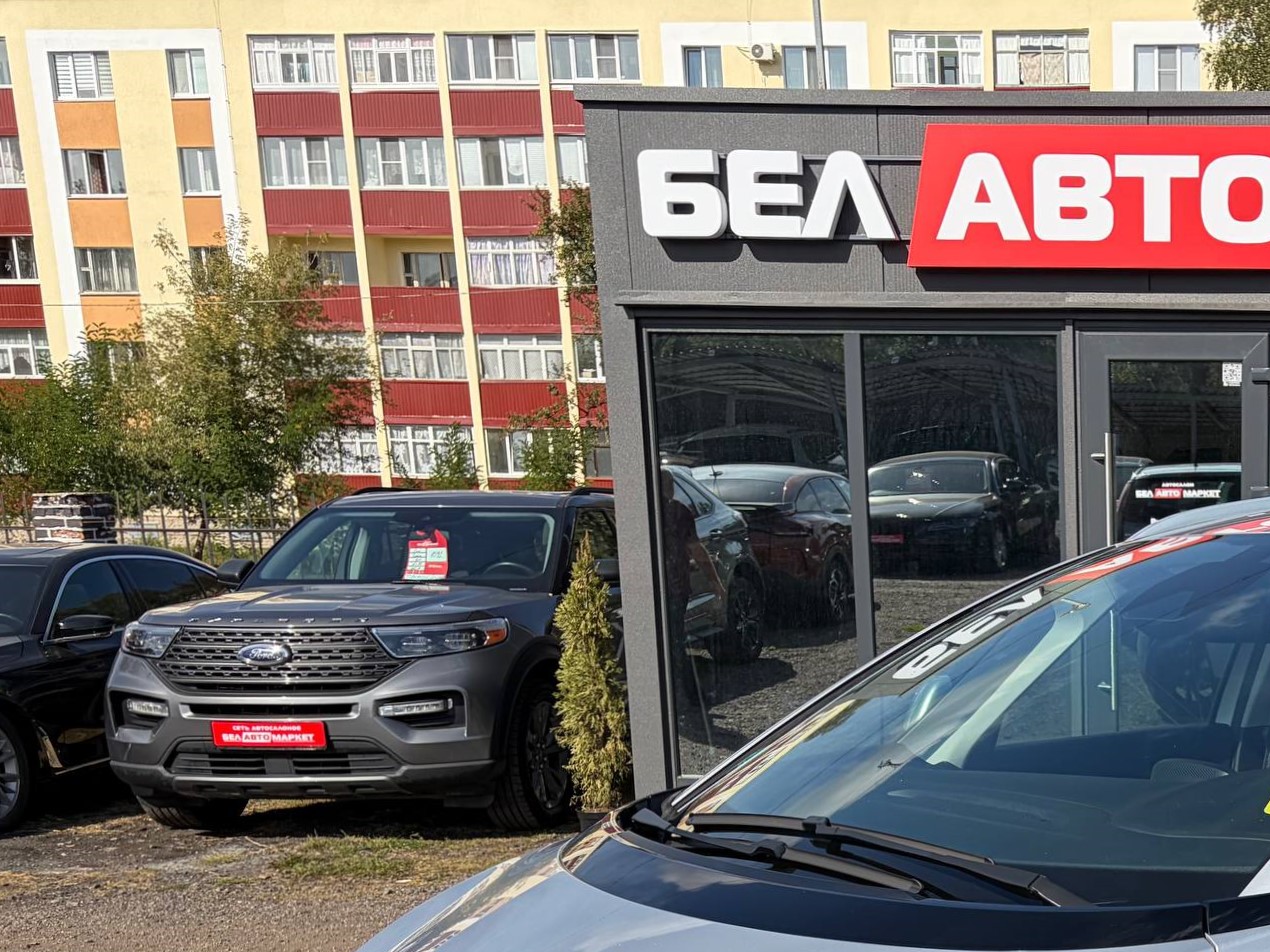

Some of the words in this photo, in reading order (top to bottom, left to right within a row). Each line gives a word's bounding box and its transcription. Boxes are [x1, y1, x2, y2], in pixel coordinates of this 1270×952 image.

[637, 149, 900, 240] БЕЛ
[1135, 489, 1153, 499] БЕЛ
[1155, 490, 1181, 498] АВТО
[1183, 489, 1221, 499] МАРКЕТ
[250, 647, 281, 661] Ford
[222, 733, 242, 743] БЕЛ
[243, 733, 270, 742] АВТО
[271, 733, 315, 743] МАРКЕТ
